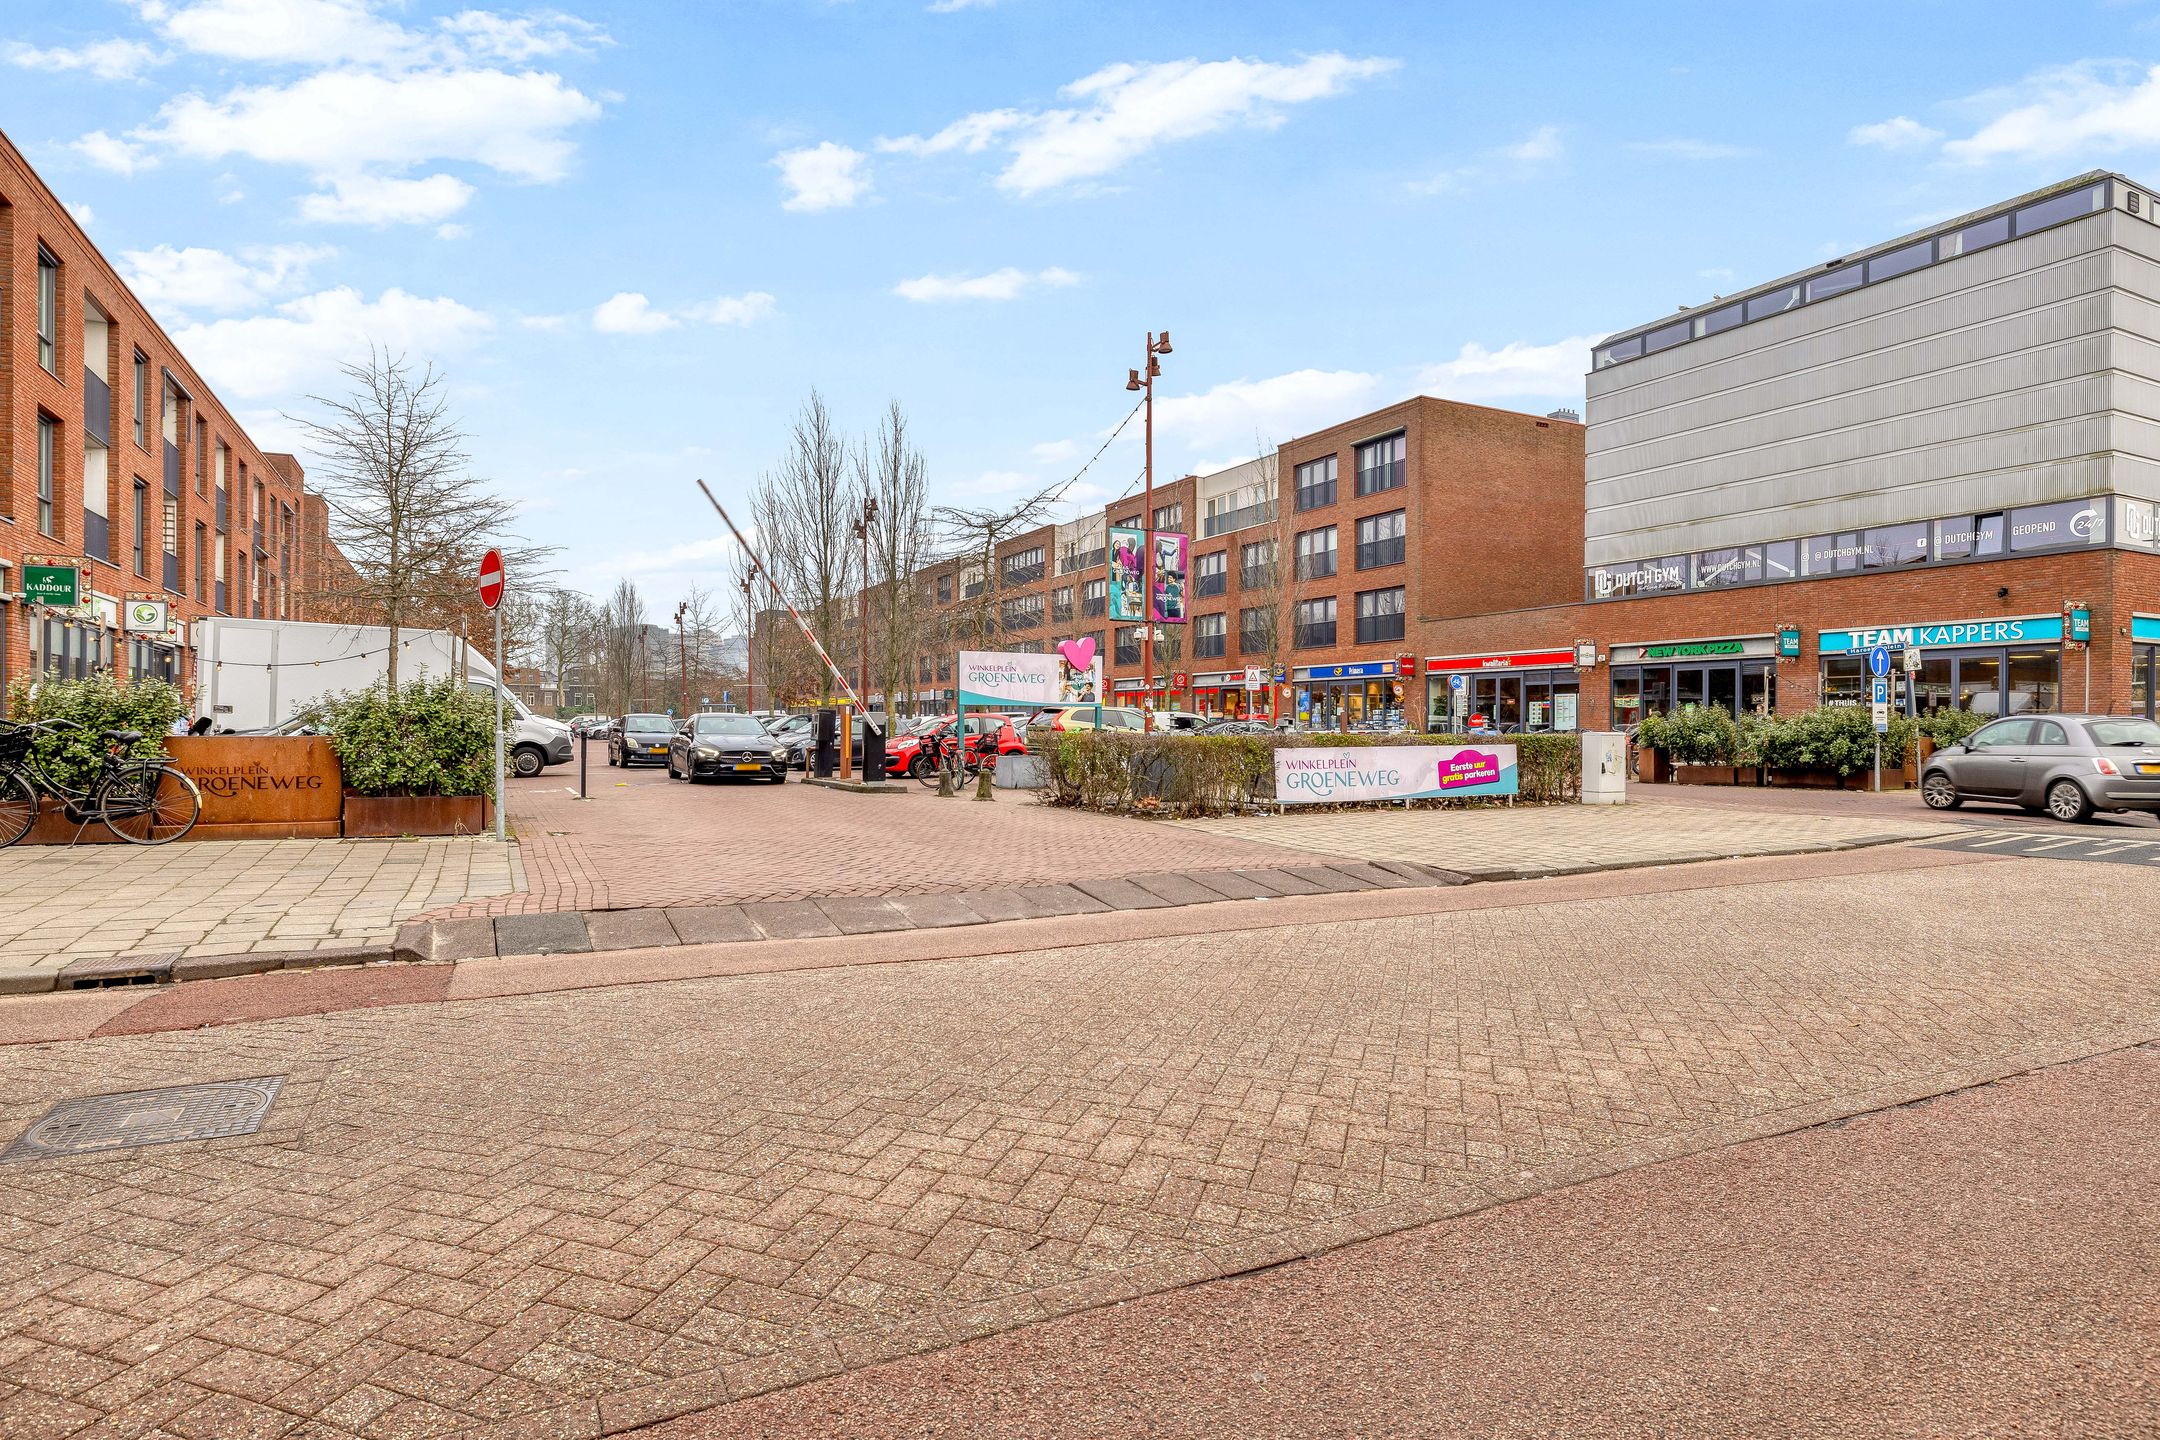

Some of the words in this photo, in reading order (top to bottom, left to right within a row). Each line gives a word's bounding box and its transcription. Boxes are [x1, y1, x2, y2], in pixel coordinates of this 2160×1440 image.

[2012, 521, 2056, 536] GEOPEND
[2077, 518, 2105, 530] 24/7
[1945, 530, 1994, 545] DUTCHGYM
[1823, 544, 1874, 559] DUTCHGYM.NL
[1700, 559, 1761, 575] WWW.DUTCHGYM.NL
[1615, 570, 1652, 588] DUTCH
[1654, 565, 1680, 585] GYM
[26, 583, 72, 593] KADDOUR
[2073, 619, 2089, 627] TEAM
[1848, 628, 1914, 648] TEAM
[1919, 620, 2025, 645] KAPPERS
[1647, 646, 1677, 658] NEW
[1675, 645, 1708, 656] YORK
[1707, 642, 1745, 654] PIZZA
[968, 664, 1017, 672] WINKELPLEIN
[968, 672, 1046, 688] GROENEWEG
[1876, 685, 1885, 700] P
[180, 764, 269, 776] WINKELPLEIN
[1285, 758, 1357, 770] WINKELPLEIN
[1449, 762, 1473, 772] Eerste
[1473, 761, 1486, 769] uur
[1286, 770, 1400, 796] GROENEWEG
[1442, 772, 1464, 784] gratis
[1464, 769, 1496, 780] parkeren
